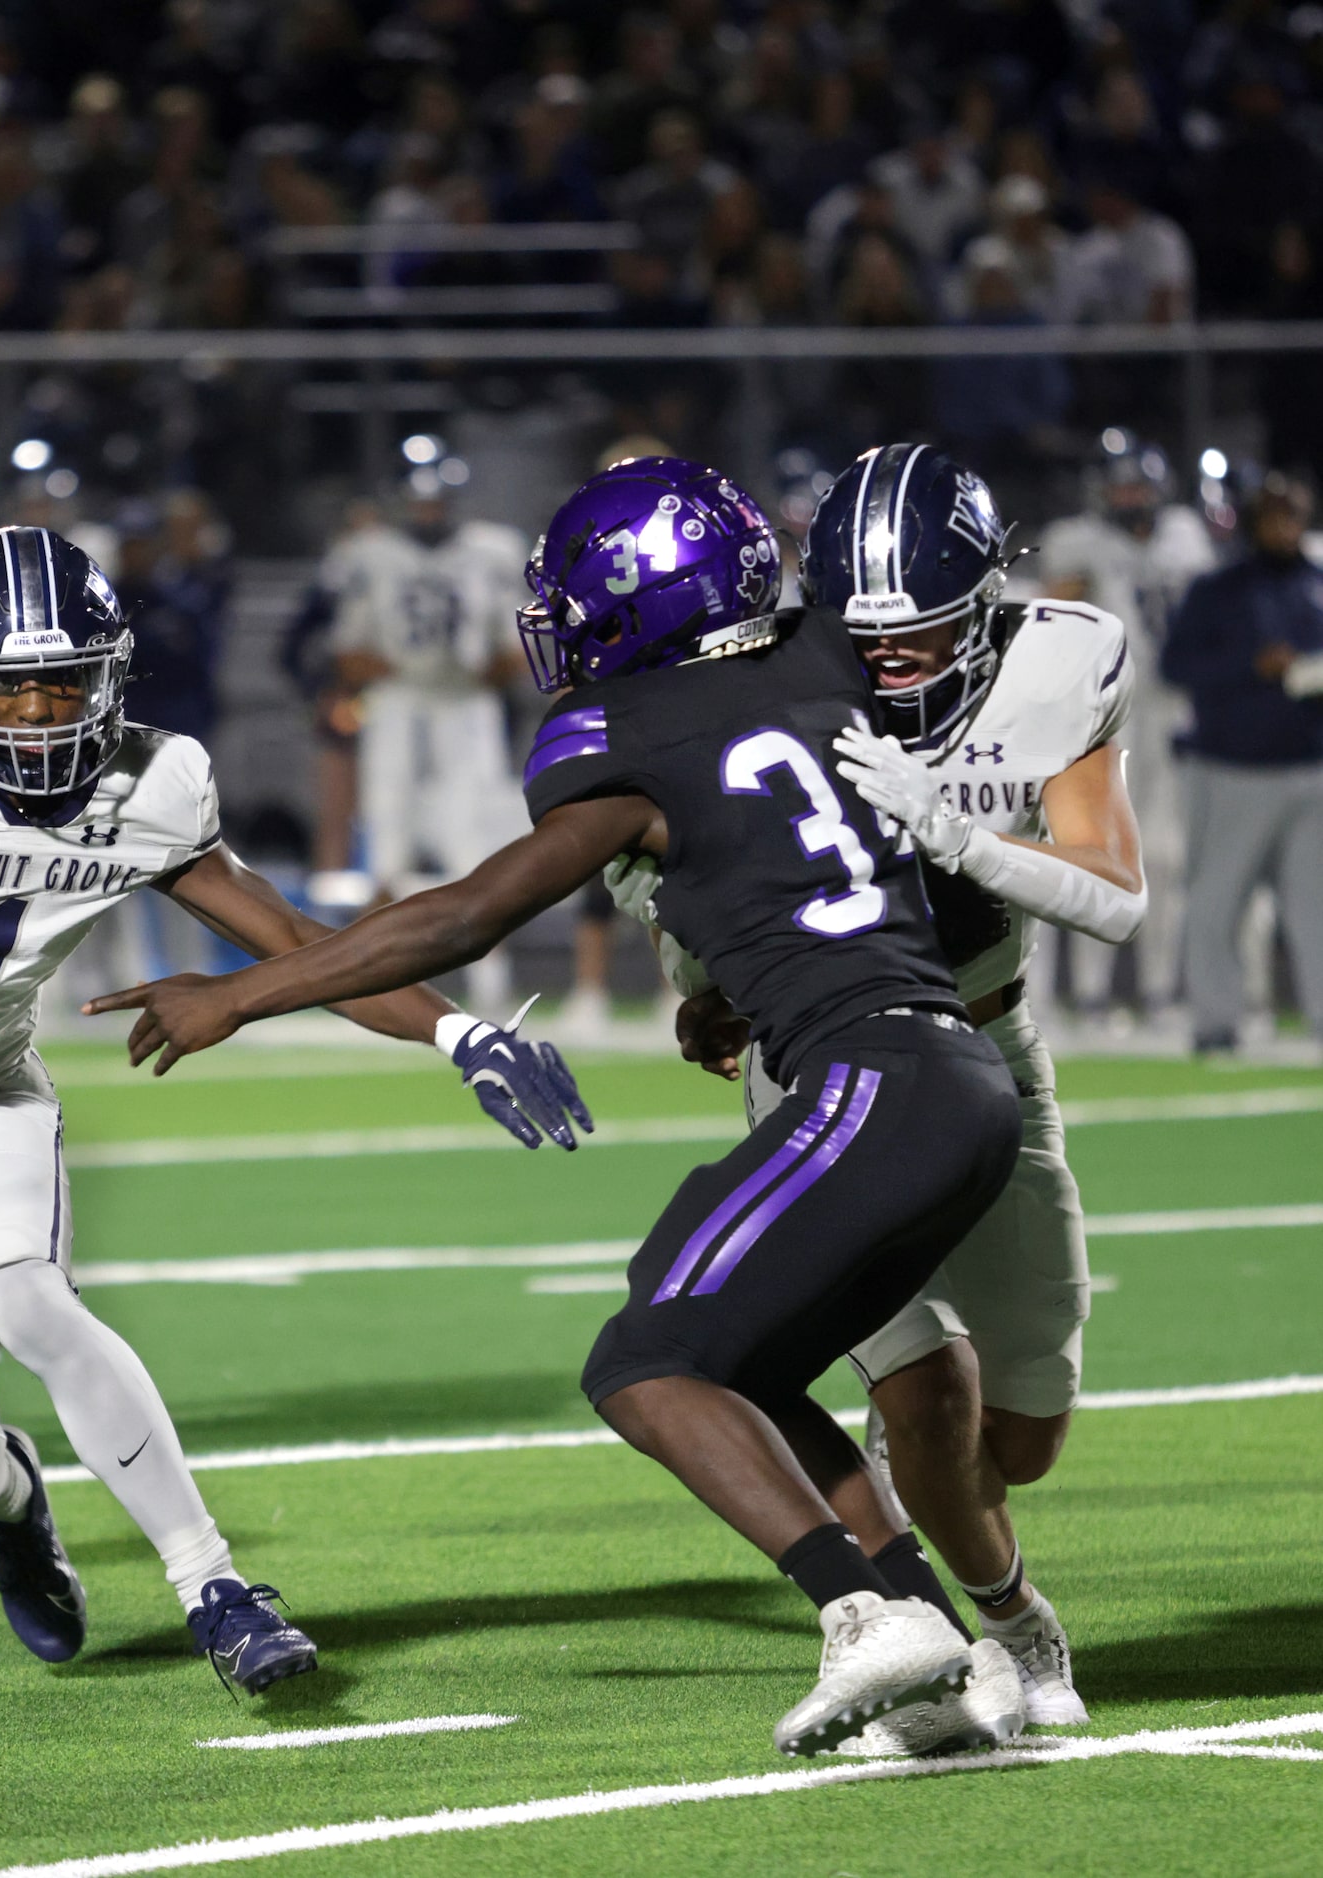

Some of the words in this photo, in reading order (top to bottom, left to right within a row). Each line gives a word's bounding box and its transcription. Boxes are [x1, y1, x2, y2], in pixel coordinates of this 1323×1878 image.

[603, 507, 678, 596] 34
[874, 597, 907, 611] GROVE
[13, 635, 32, 647] THE
[33, 633, 65, 646] GROVE
[939, 780, 1037, 816] GROVE
[44, 856, 140, 894] GROVE
